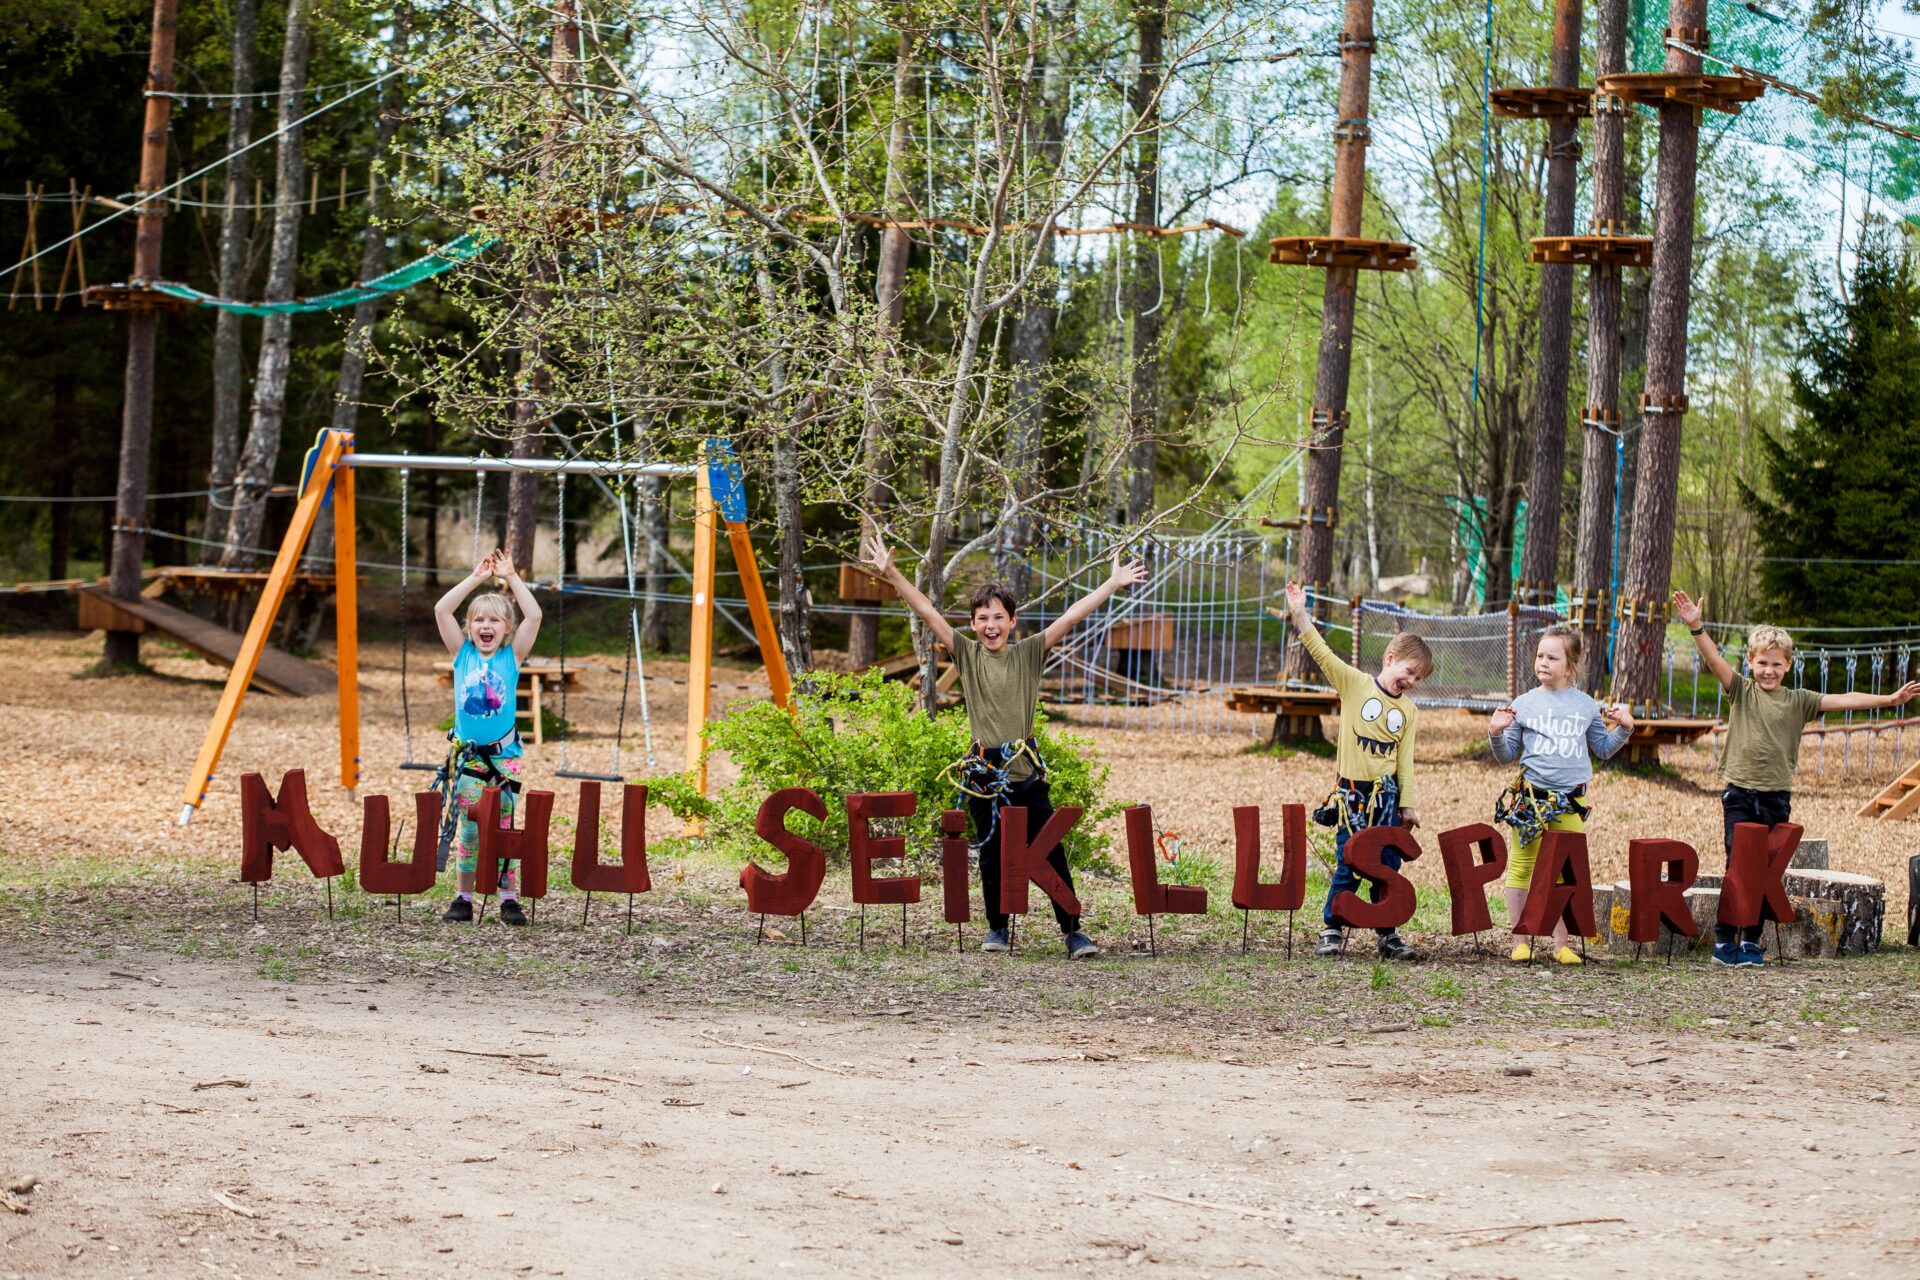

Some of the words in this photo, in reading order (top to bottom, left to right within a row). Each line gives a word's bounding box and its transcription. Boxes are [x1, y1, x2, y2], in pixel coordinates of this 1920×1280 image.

[1526, 708, 1587, 737] what
[1533, 734, 1583, 760] ever
[240, 768, 652, 899] MUHU
